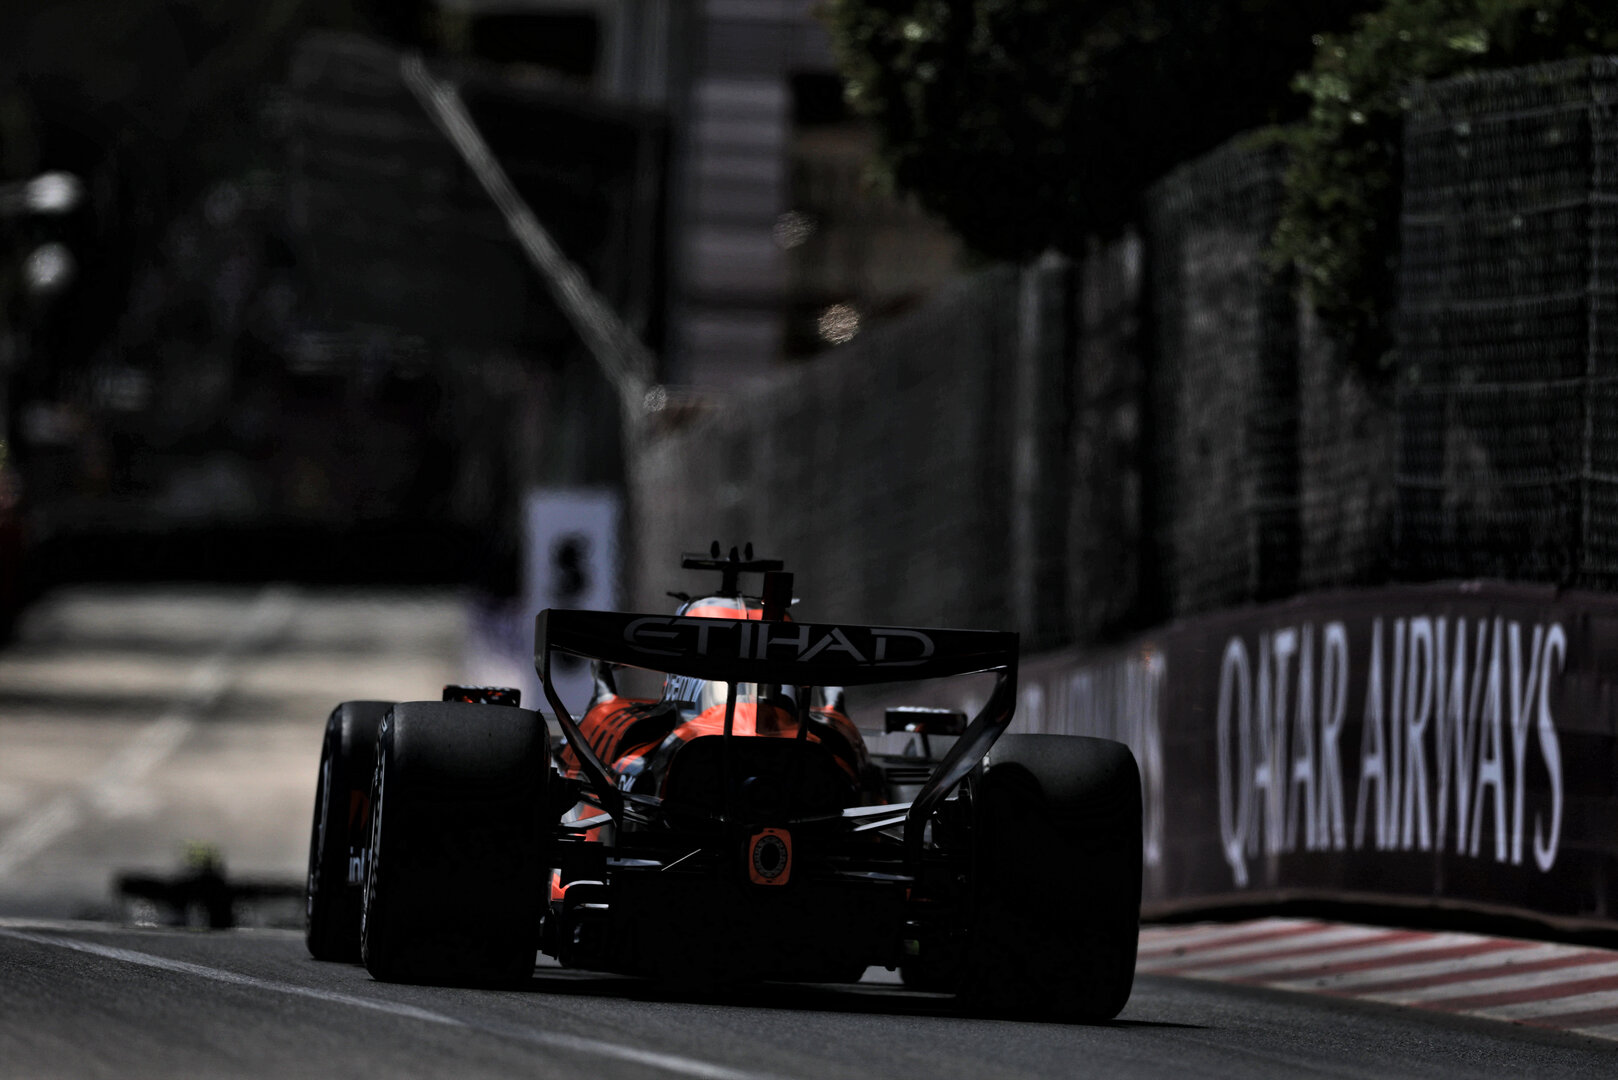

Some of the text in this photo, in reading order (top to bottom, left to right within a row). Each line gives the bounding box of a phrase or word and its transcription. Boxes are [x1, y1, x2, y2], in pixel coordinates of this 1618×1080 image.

[622, 616, 936, 667] ETIHAD
[1216, 620, 1349, 888] QATAR
[1353, 614, 1568, 874] AIRWAYS
